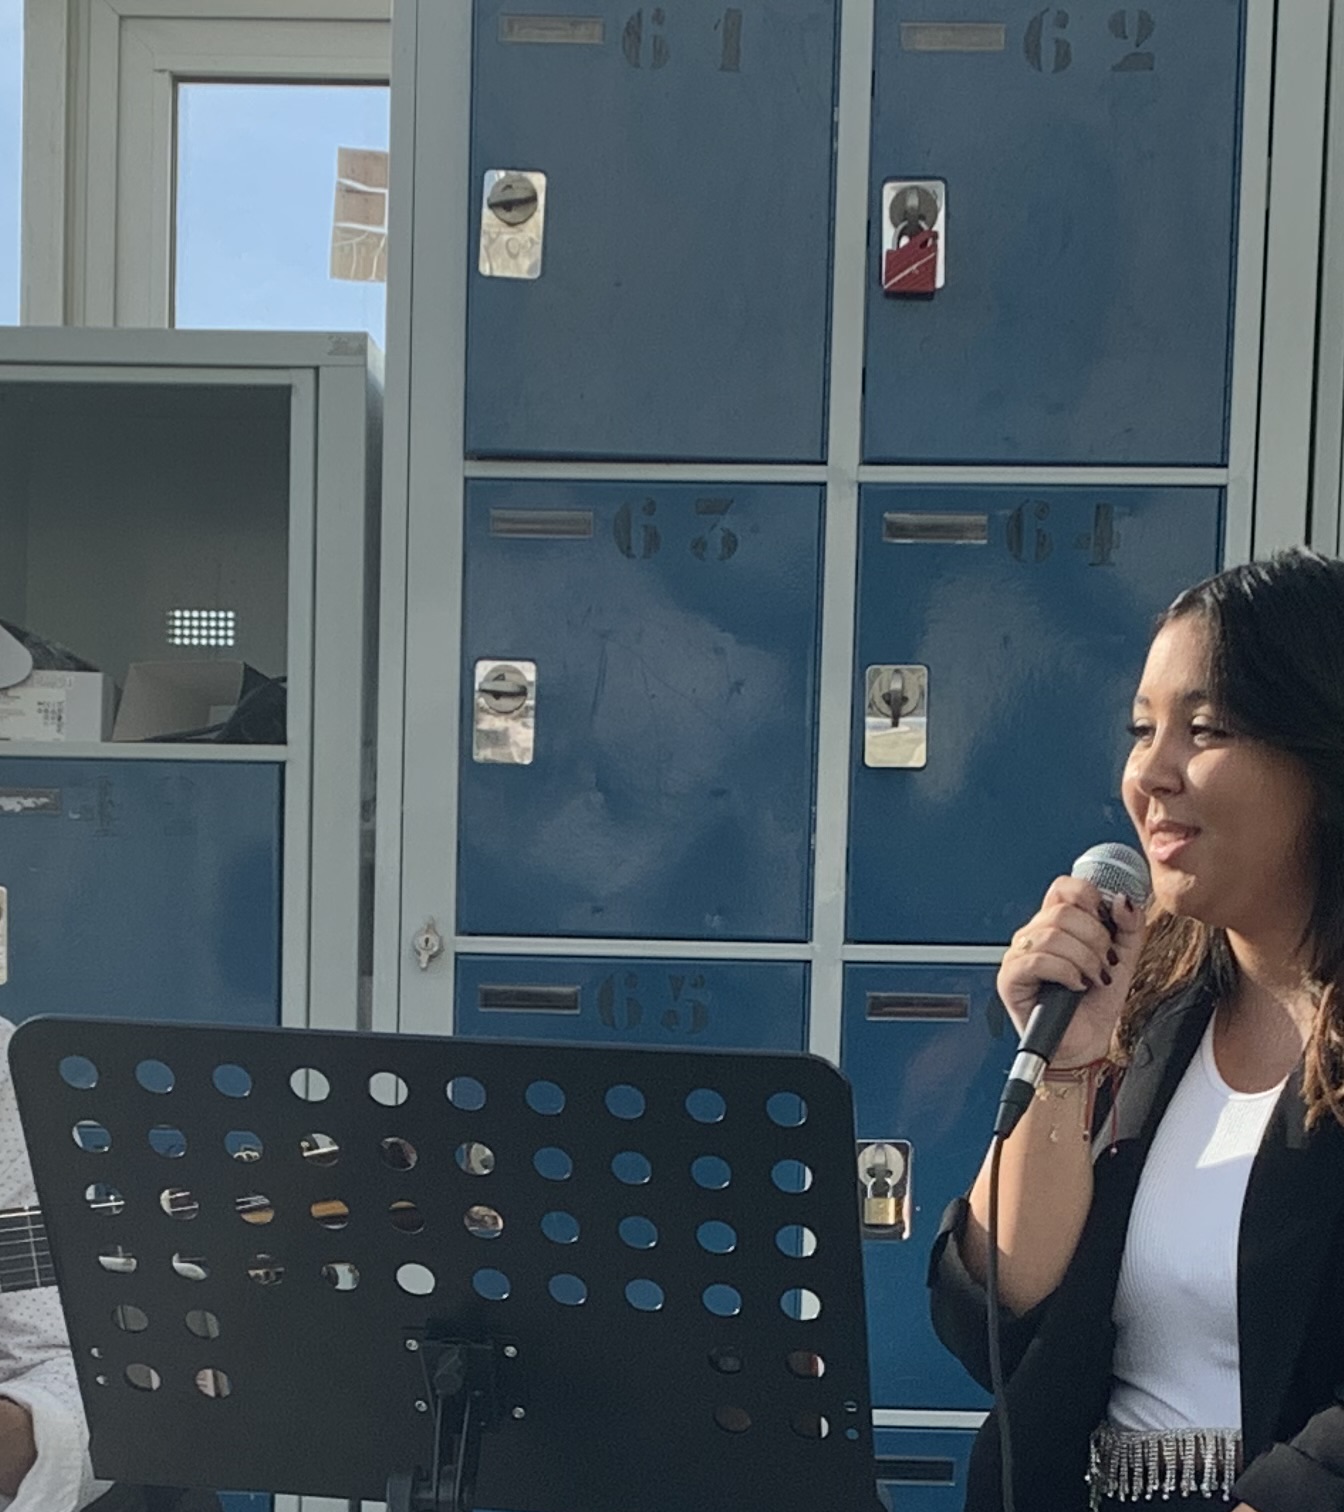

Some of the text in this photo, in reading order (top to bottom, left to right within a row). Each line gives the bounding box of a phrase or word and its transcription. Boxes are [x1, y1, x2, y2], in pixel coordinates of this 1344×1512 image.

[622, 7, 742, 73] 61
[1023, 6, 1156, 74] 62
[613, 497, 740, 562] 63
[1004, 498, 1125, 567] 64
[596, 972, 709, 1034] 65
